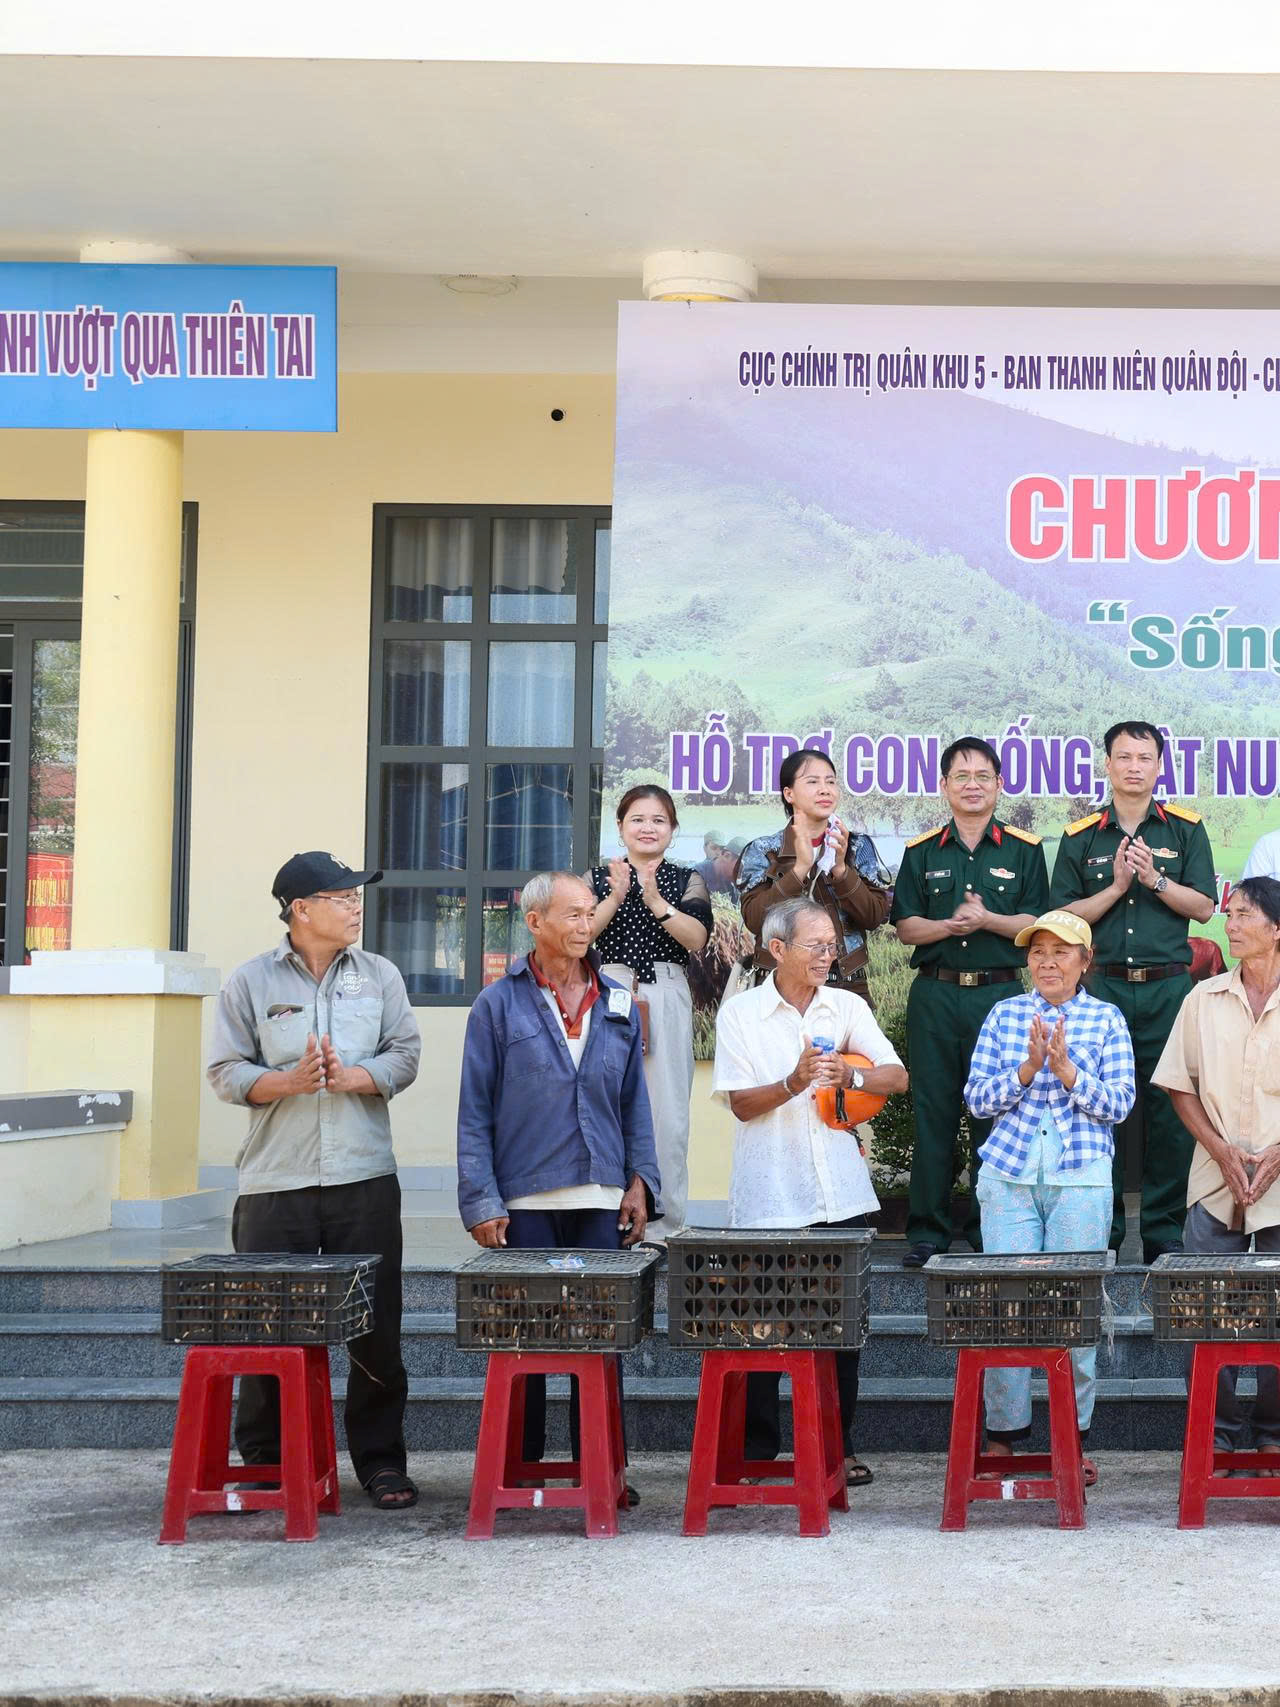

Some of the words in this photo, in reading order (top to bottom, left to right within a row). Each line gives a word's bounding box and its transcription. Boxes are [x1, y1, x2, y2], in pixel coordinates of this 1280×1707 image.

[45, 306, 116, 389] VƯỢT
[122, 313, 178, 383] QUA
[184, 301, 266, 377] THIÊN
[272, 314, 314, 378] TAI
[739, 351, 776, 394] CỤC
[781, 344, 838, 387] CHÍNH
[842, 352, 871, 398] TRỊ
[877, 346, 927, 392] QUÂN
[932, 354, 969, 389] KHU
[974, 355, 986, 390] 5
[1004, 355, 1042, 390] BAN
[1047, 355, 1107, 391] THANH
[1112, 349, 1156, 391] NIÊN
[1162, 349, 1212, 396] QUÂN
[1216, 349, 1247, 400] ĐỘI
[672, 713, 733, 793] HỖ
[846, 734, 939, 798] CON
